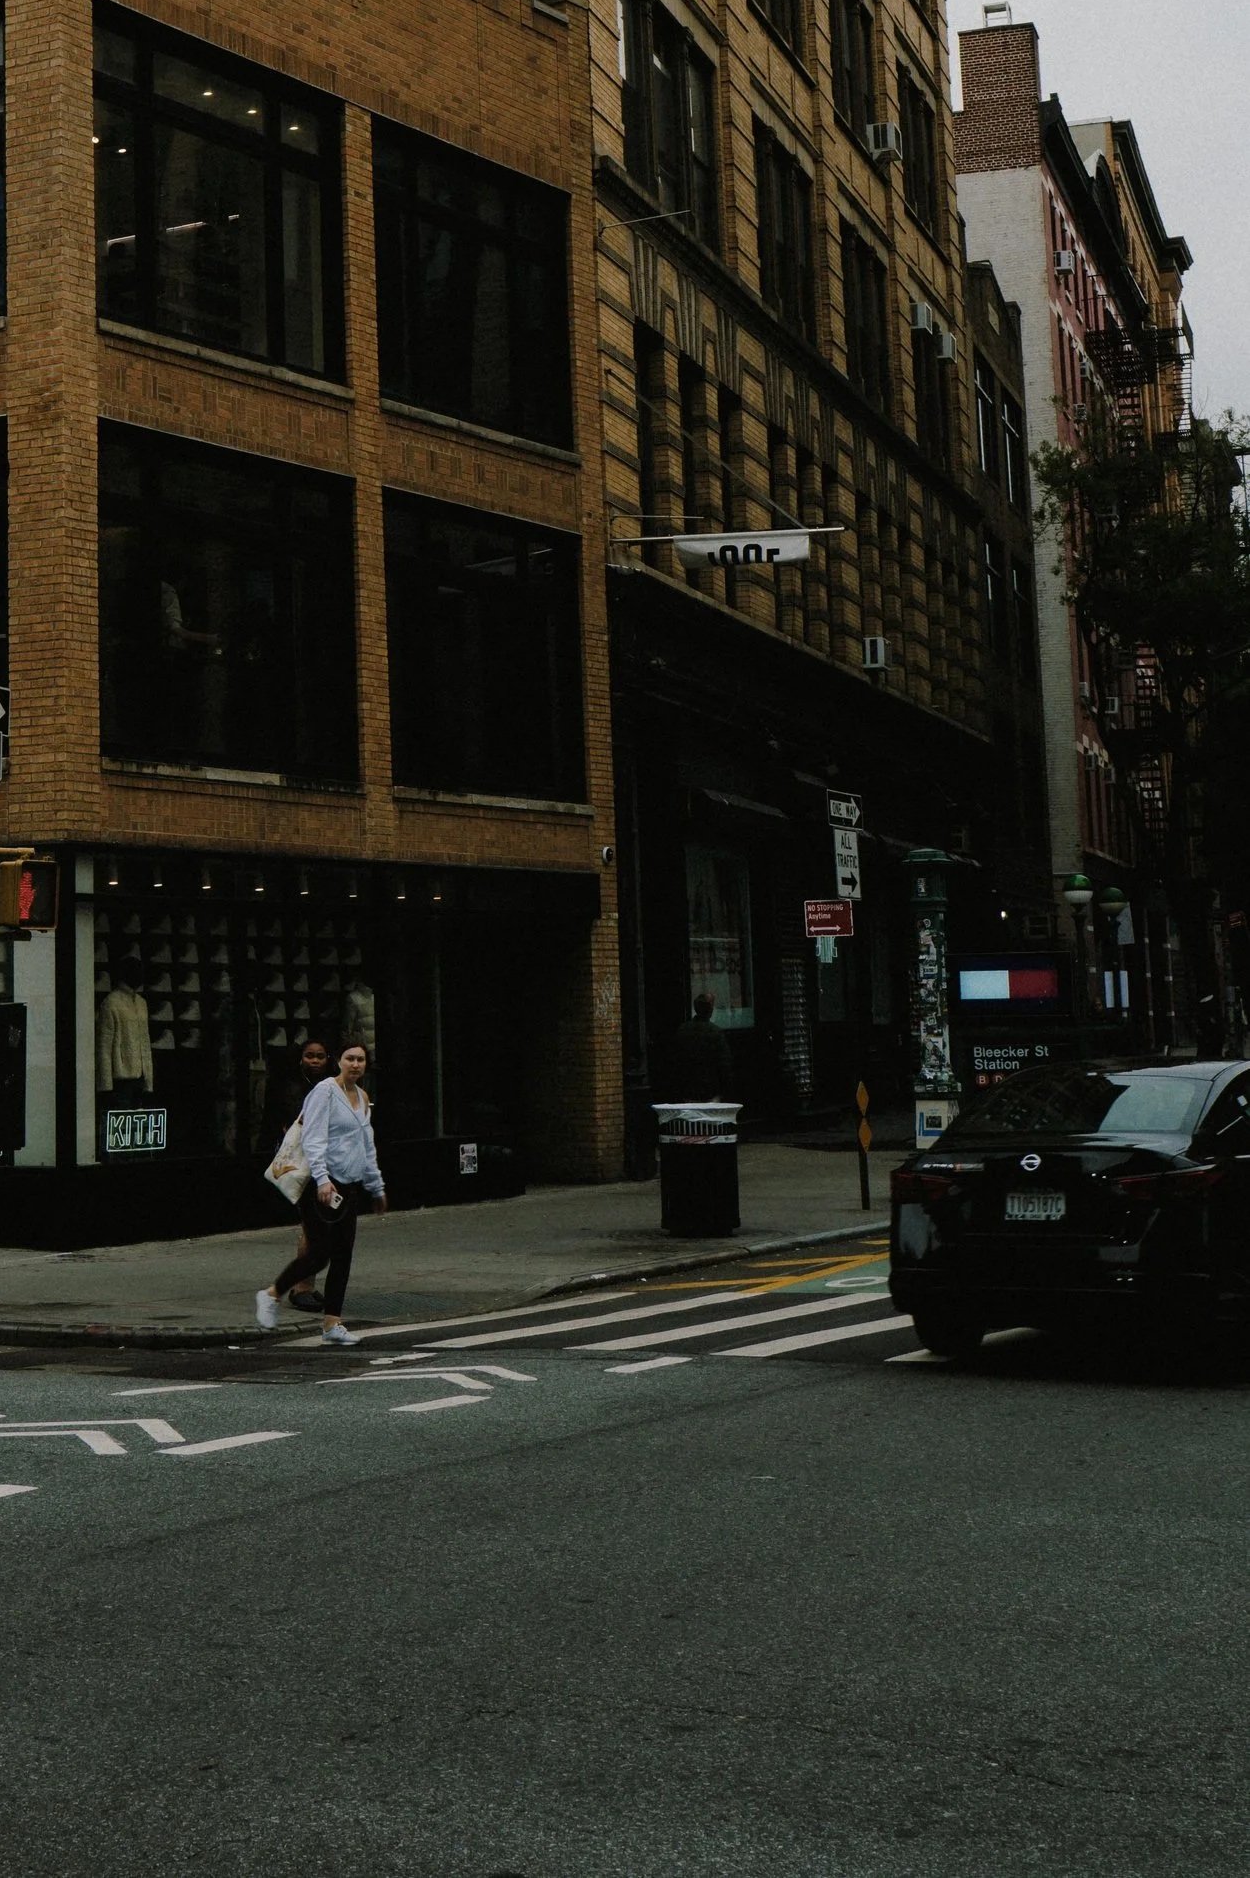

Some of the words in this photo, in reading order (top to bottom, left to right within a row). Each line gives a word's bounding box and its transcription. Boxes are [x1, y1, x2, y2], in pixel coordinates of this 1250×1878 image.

[831, 801, 842, 816] ONE
[845, 804, 857, 819] WAY
[840, 833, 852, 850] ALL
[837, 853, 858, 869] TRAFFIC
[973, 1046, 1029, 1057] Bleecker
[1034, 1045, 1049, 1057] St
[974, 1058, 1020, 1070] Station
[979, 1075, 986, 1084] B
[110, 1113, 164, 1147] KITH
